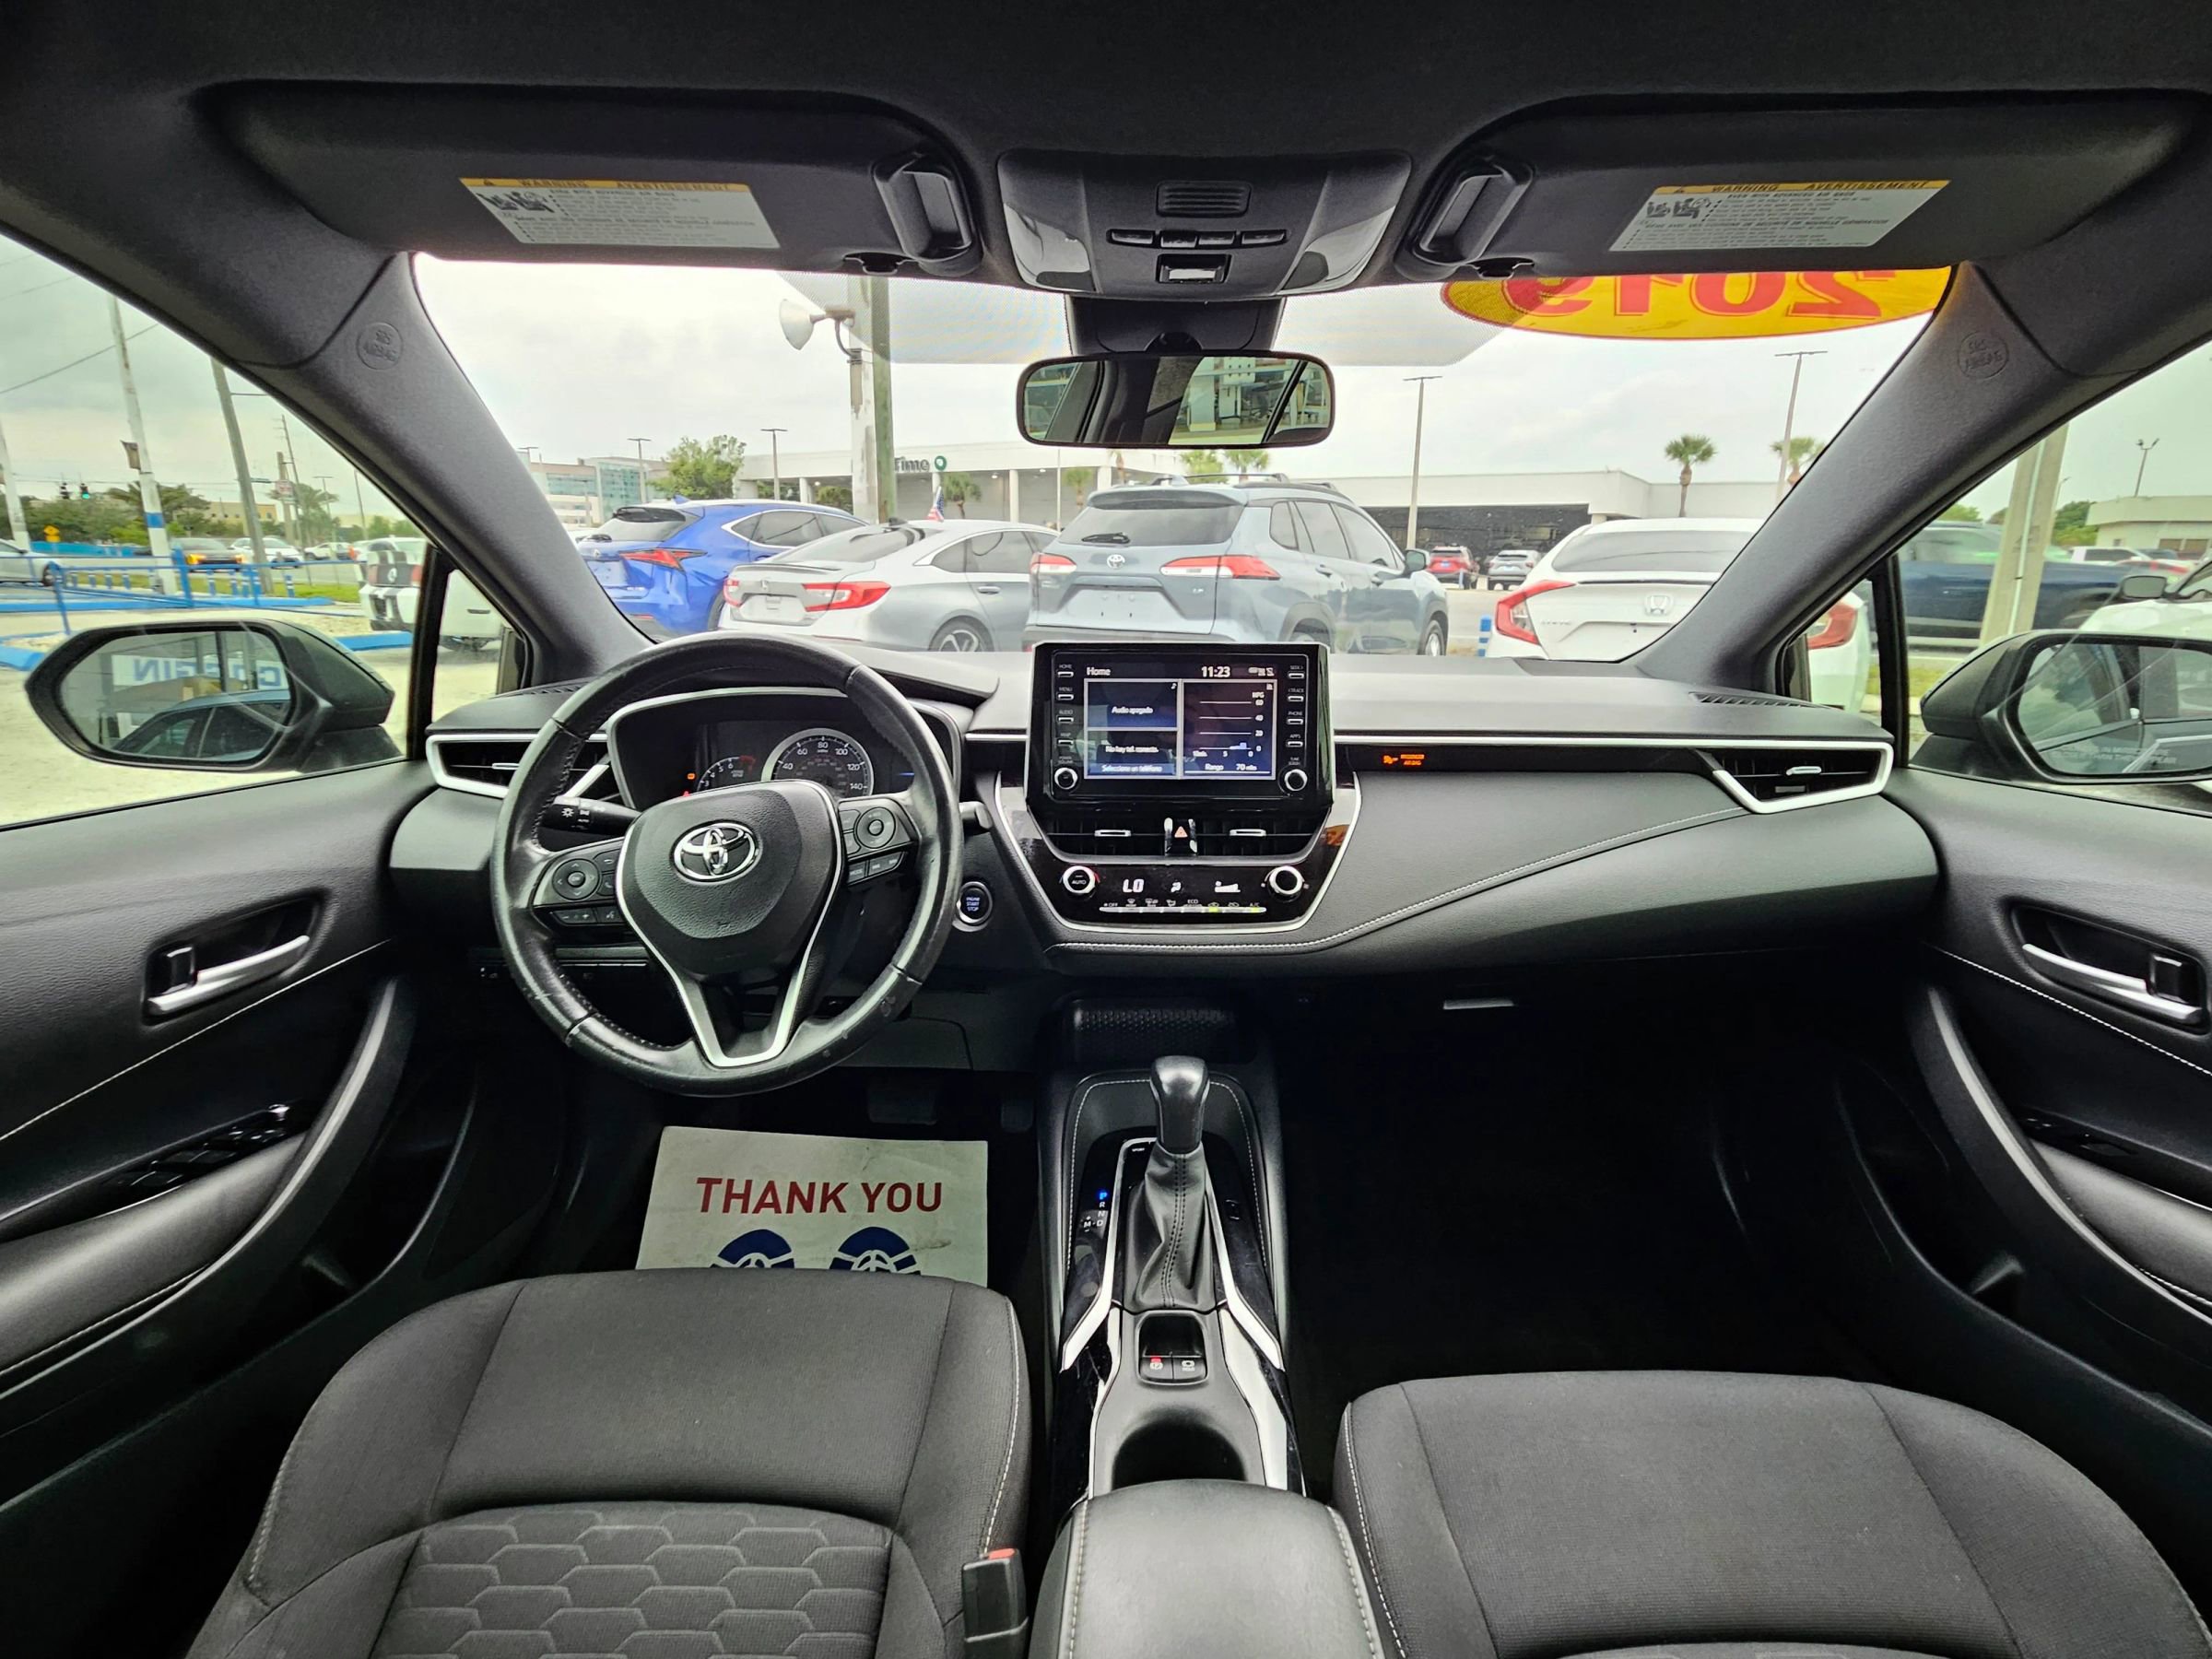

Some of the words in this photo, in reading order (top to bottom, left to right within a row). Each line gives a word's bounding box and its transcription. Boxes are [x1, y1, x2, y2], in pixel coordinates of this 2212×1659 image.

[1805, 181, 1928, 190] AVERTISSEMENT
[1087, 667, 1111, 676] Home
[1201, 666, 1231, 678] 11:23
[1123, 878, 1145, 893] LO
[696, 1177, 848, 1214] THANK
[861, 1182, 942, 1213] YOU
[1099, 1192, 1108, 1200] P
